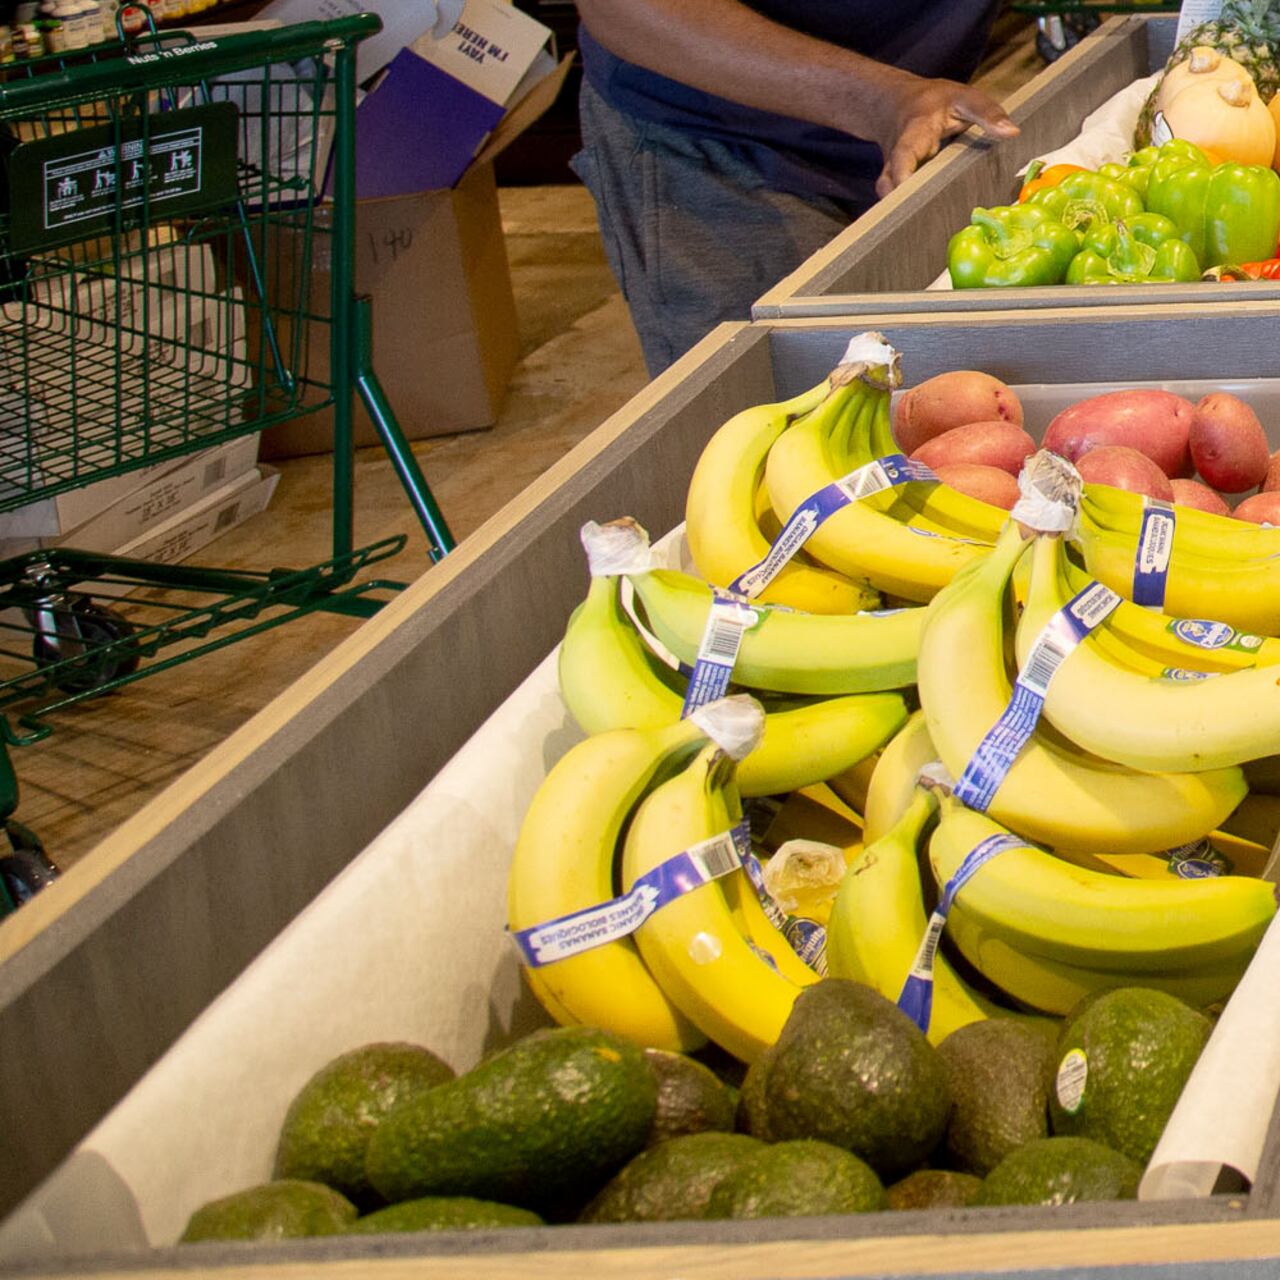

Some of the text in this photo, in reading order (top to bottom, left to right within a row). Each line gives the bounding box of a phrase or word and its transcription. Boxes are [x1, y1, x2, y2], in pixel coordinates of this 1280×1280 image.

[128, 53, 160, 65] Nuts
[172, 41, 218, 56] Berries
[458, 41, 485, 64] YAY!
[559, 927, 608, 950] BANANAS
